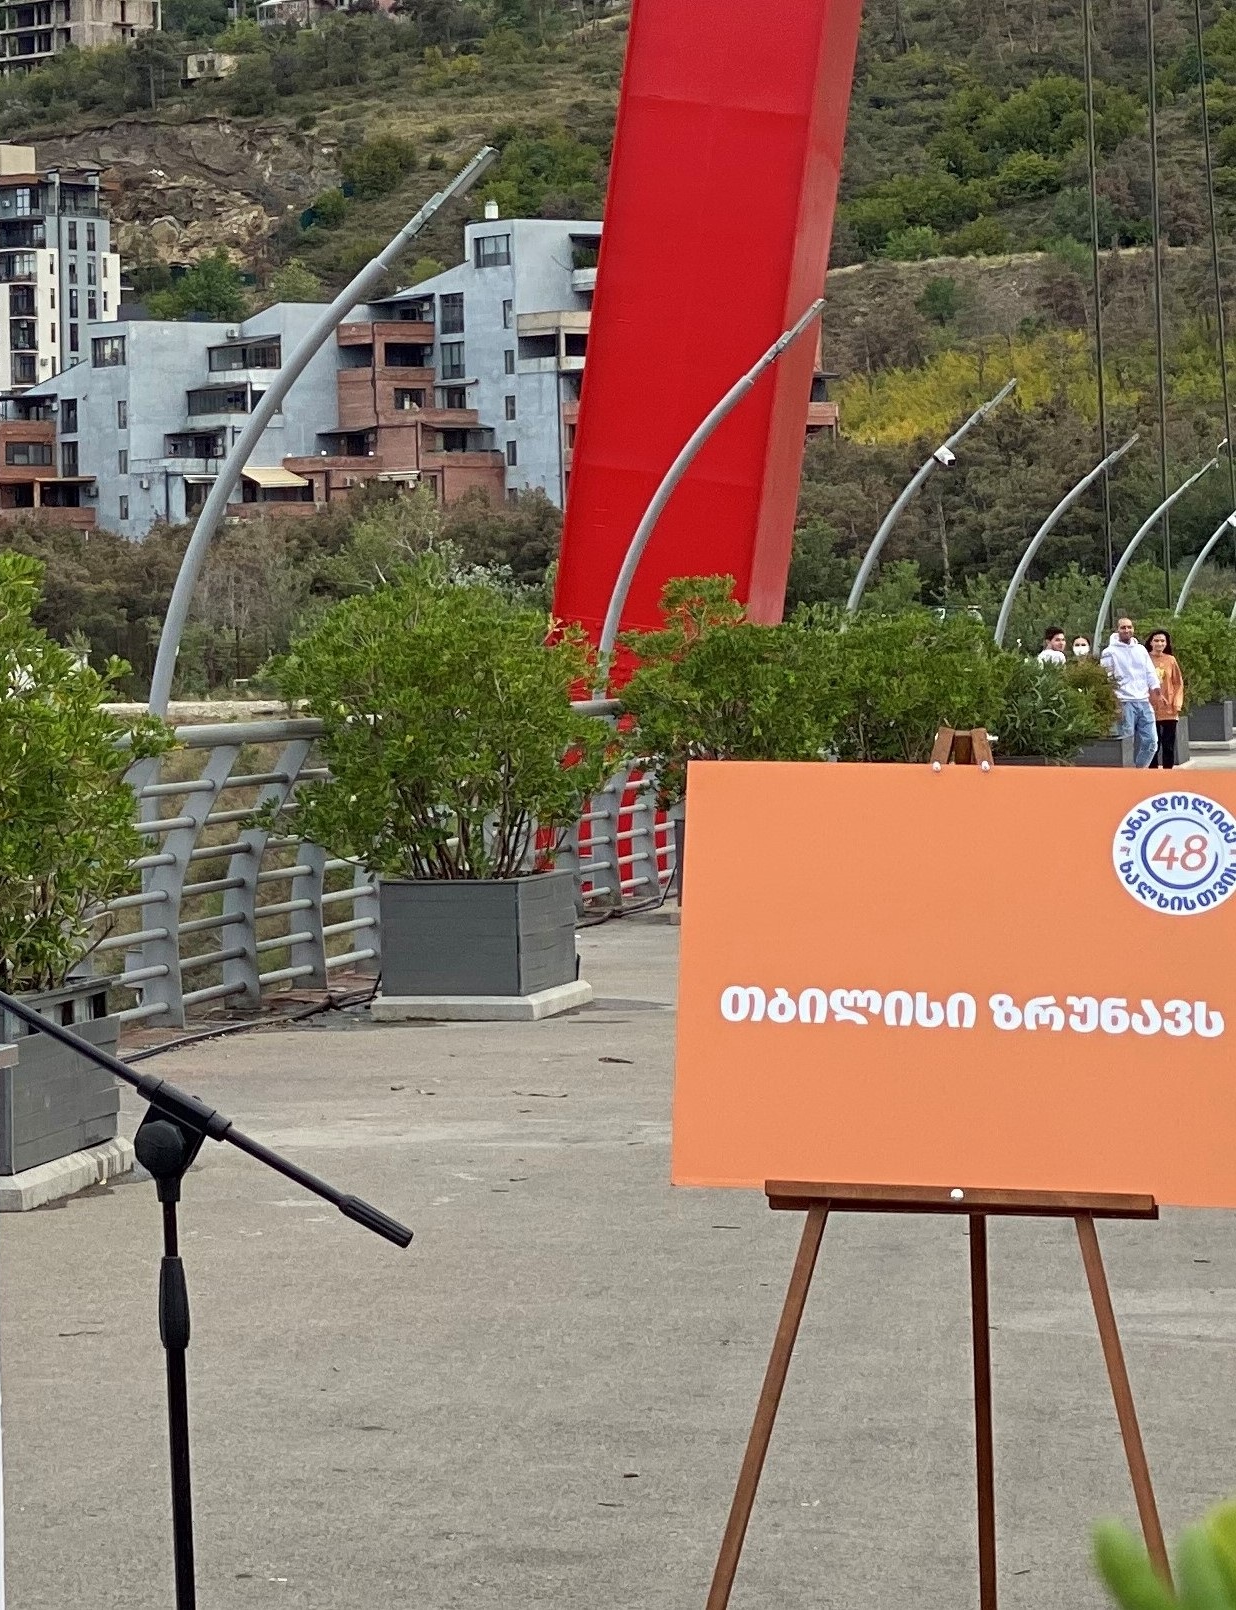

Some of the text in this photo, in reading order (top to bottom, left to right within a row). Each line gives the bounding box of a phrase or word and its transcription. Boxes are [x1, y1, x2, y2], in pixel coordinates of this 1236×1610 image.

[1121, 807, 1152, 841] ანა
[1151, 834, 1208, 871] 48
[720, 985, 1226, 1038] თბილისი ზრუნავს
